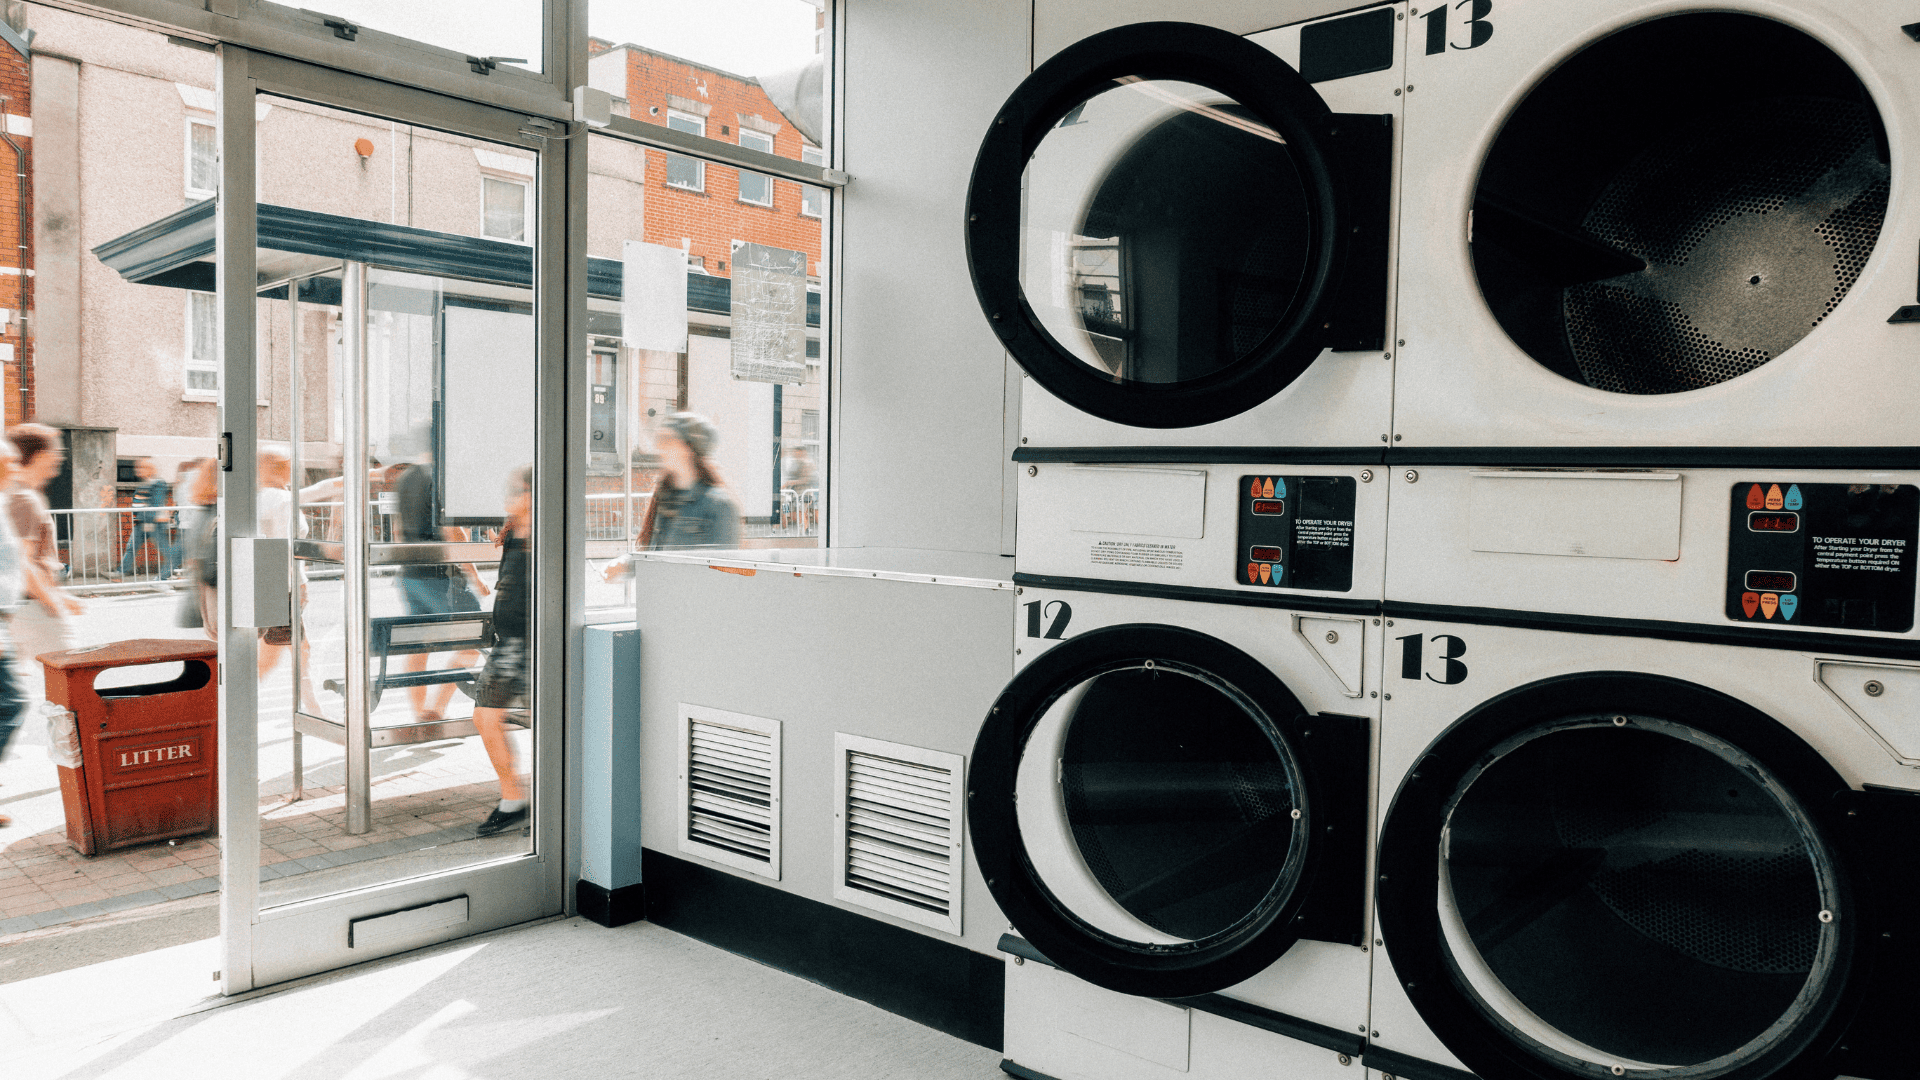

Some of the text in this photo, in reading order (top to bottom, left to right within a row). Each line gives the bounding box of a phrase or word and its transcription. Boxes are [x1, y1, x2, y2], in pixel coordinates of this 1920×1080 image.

[1419, 0, 1494, 56] 13
[1023, 600, 1072, 640] 12
[1395, 633, 1468, 685] 13
[121, 744, 192, 766] LITTER
